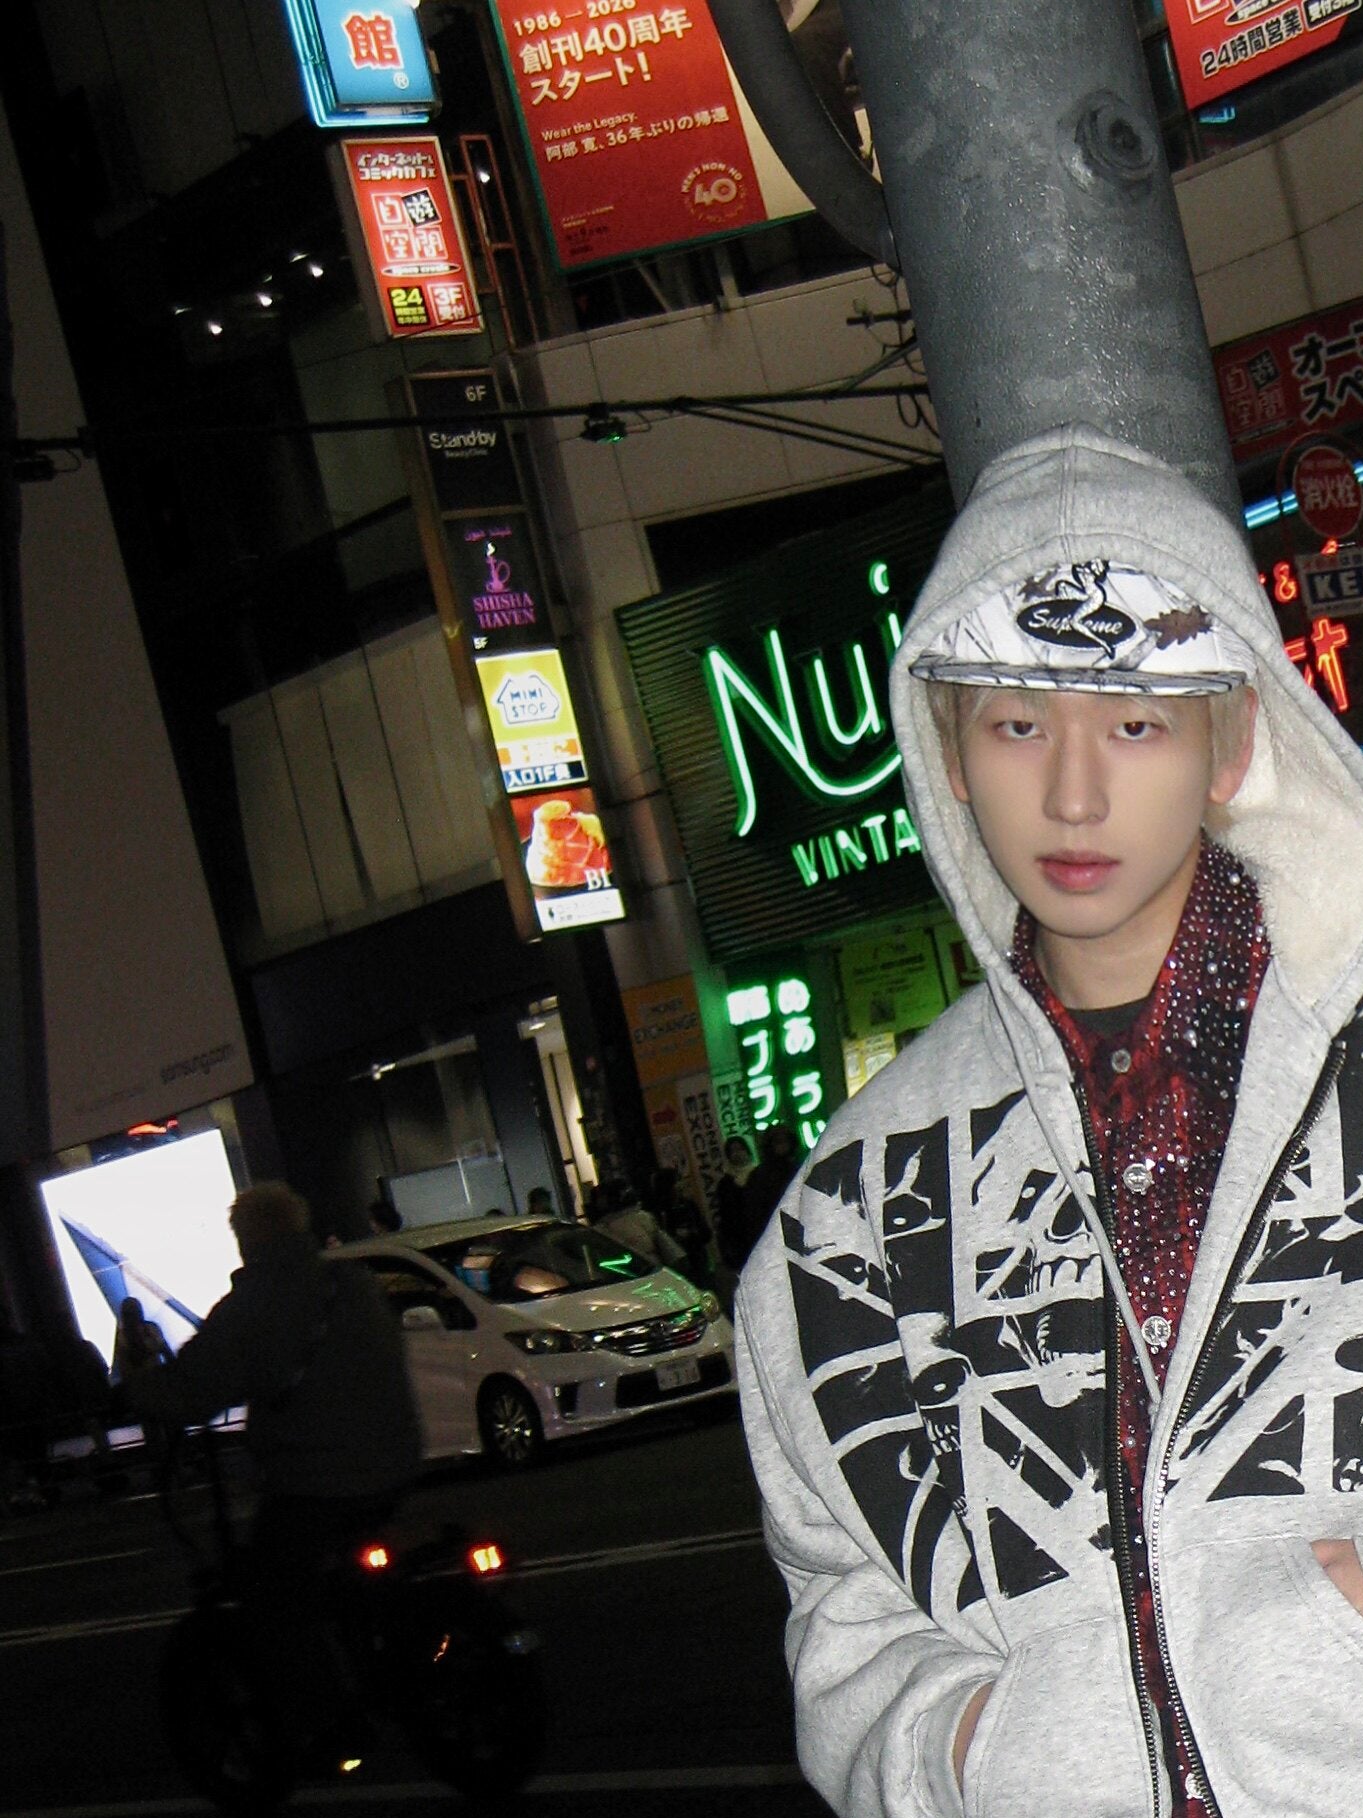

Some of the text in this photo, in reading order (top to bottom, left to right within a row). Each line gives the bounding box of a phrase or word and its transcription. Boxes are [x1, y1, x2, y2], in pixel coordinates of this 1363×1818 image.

[512, 11, 562, 37] 1986
[343, 12, 404, 70] 館
[519, 8, 692, 75] 創刊40周年
[1201, 6, 1304, 79] 24時間営業
[530, 52, 652, 105] スタート!
[541, 112, 638, 142] Wear the Legacy.
[390, 288, 423, 306] 24
[432, 287, 463, 305] 3F
[465, 385, 487, 401] 6F
[478, 609, 536, 628] HAVEN
[509, 687, 544, 702] MINI
[511, 702, 549, 719] STOP
